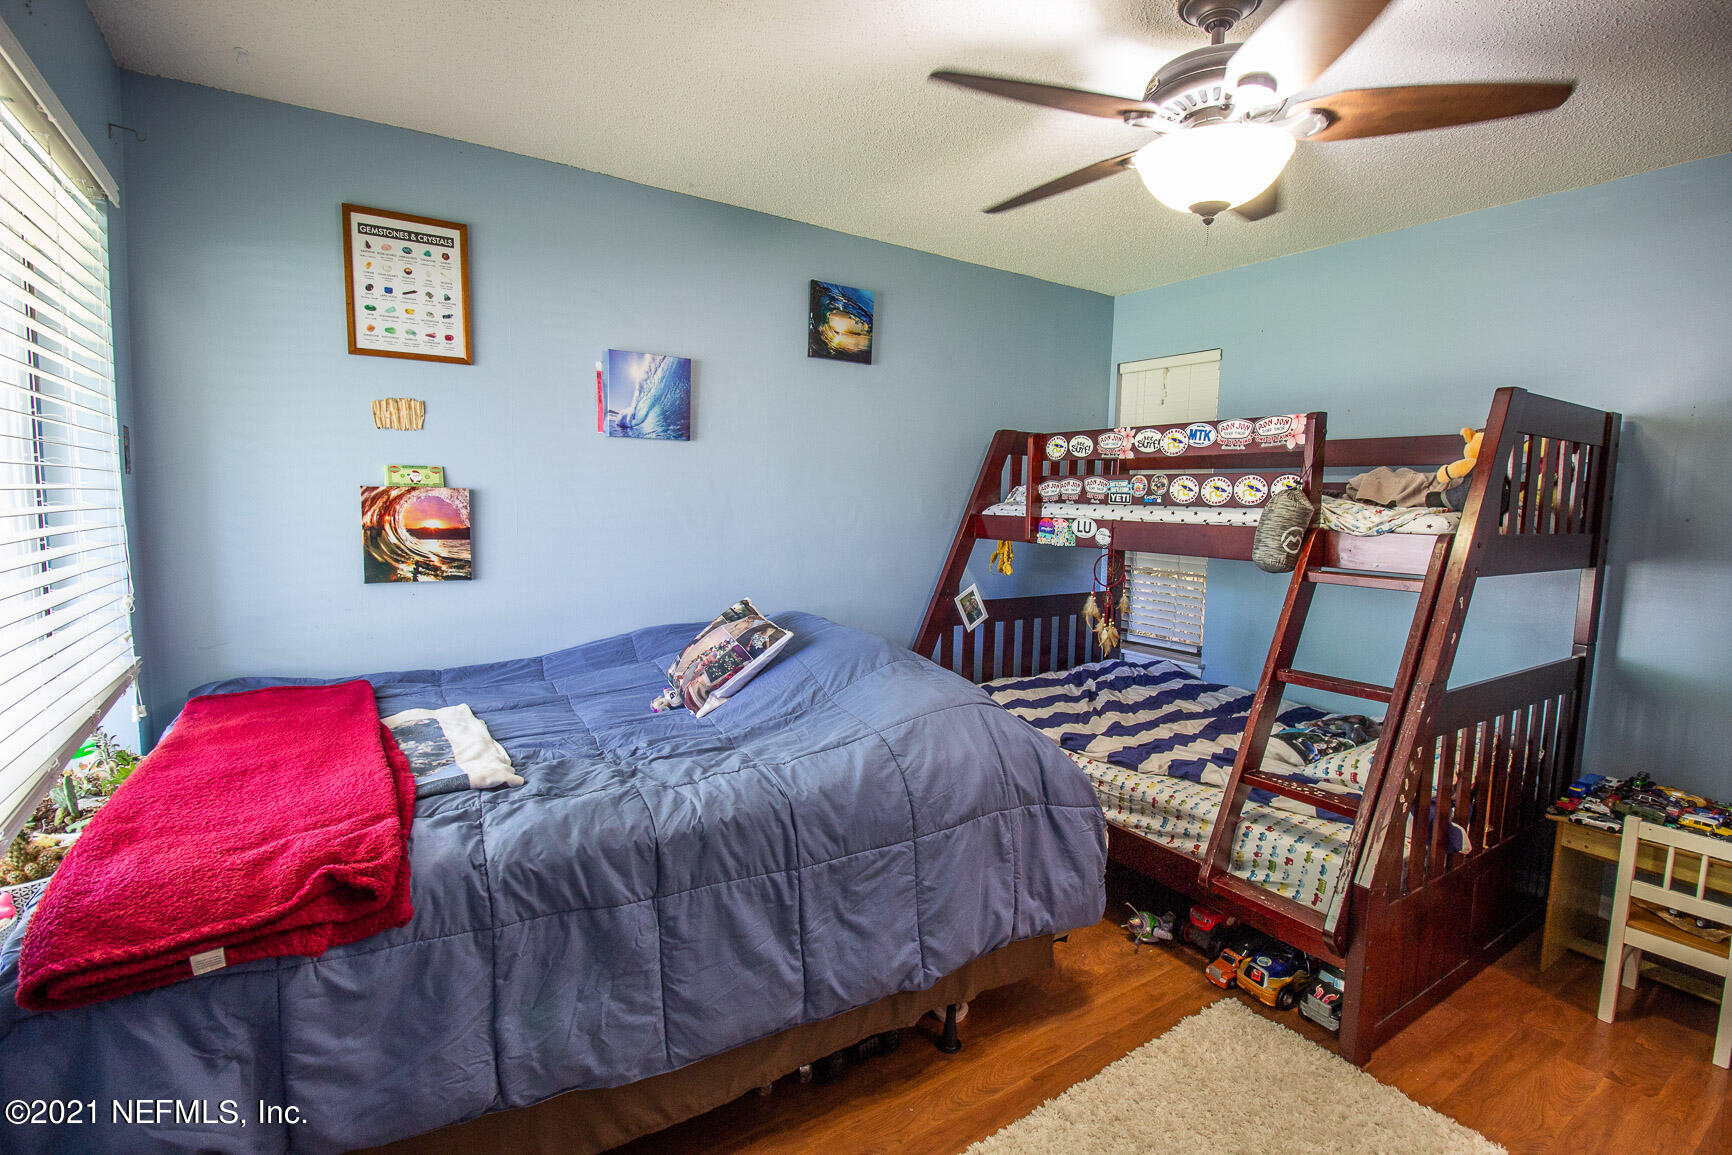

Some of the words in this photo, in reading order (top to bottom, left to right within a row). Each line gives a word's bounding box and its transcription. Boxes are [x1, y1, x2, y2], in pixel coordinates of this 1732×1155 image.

[360, 225, 409, 239] GEMSTONES
[418, 234, 453, 247] CRYSTALS
[1221, 423, 1235, 432] RON
[1258, 419, 1273, 429] RON
[1188, 429, 1212, 441] MTK
[1110, 494, 1130, 502] YETI
[1077, 521, 1091, 533] LU
